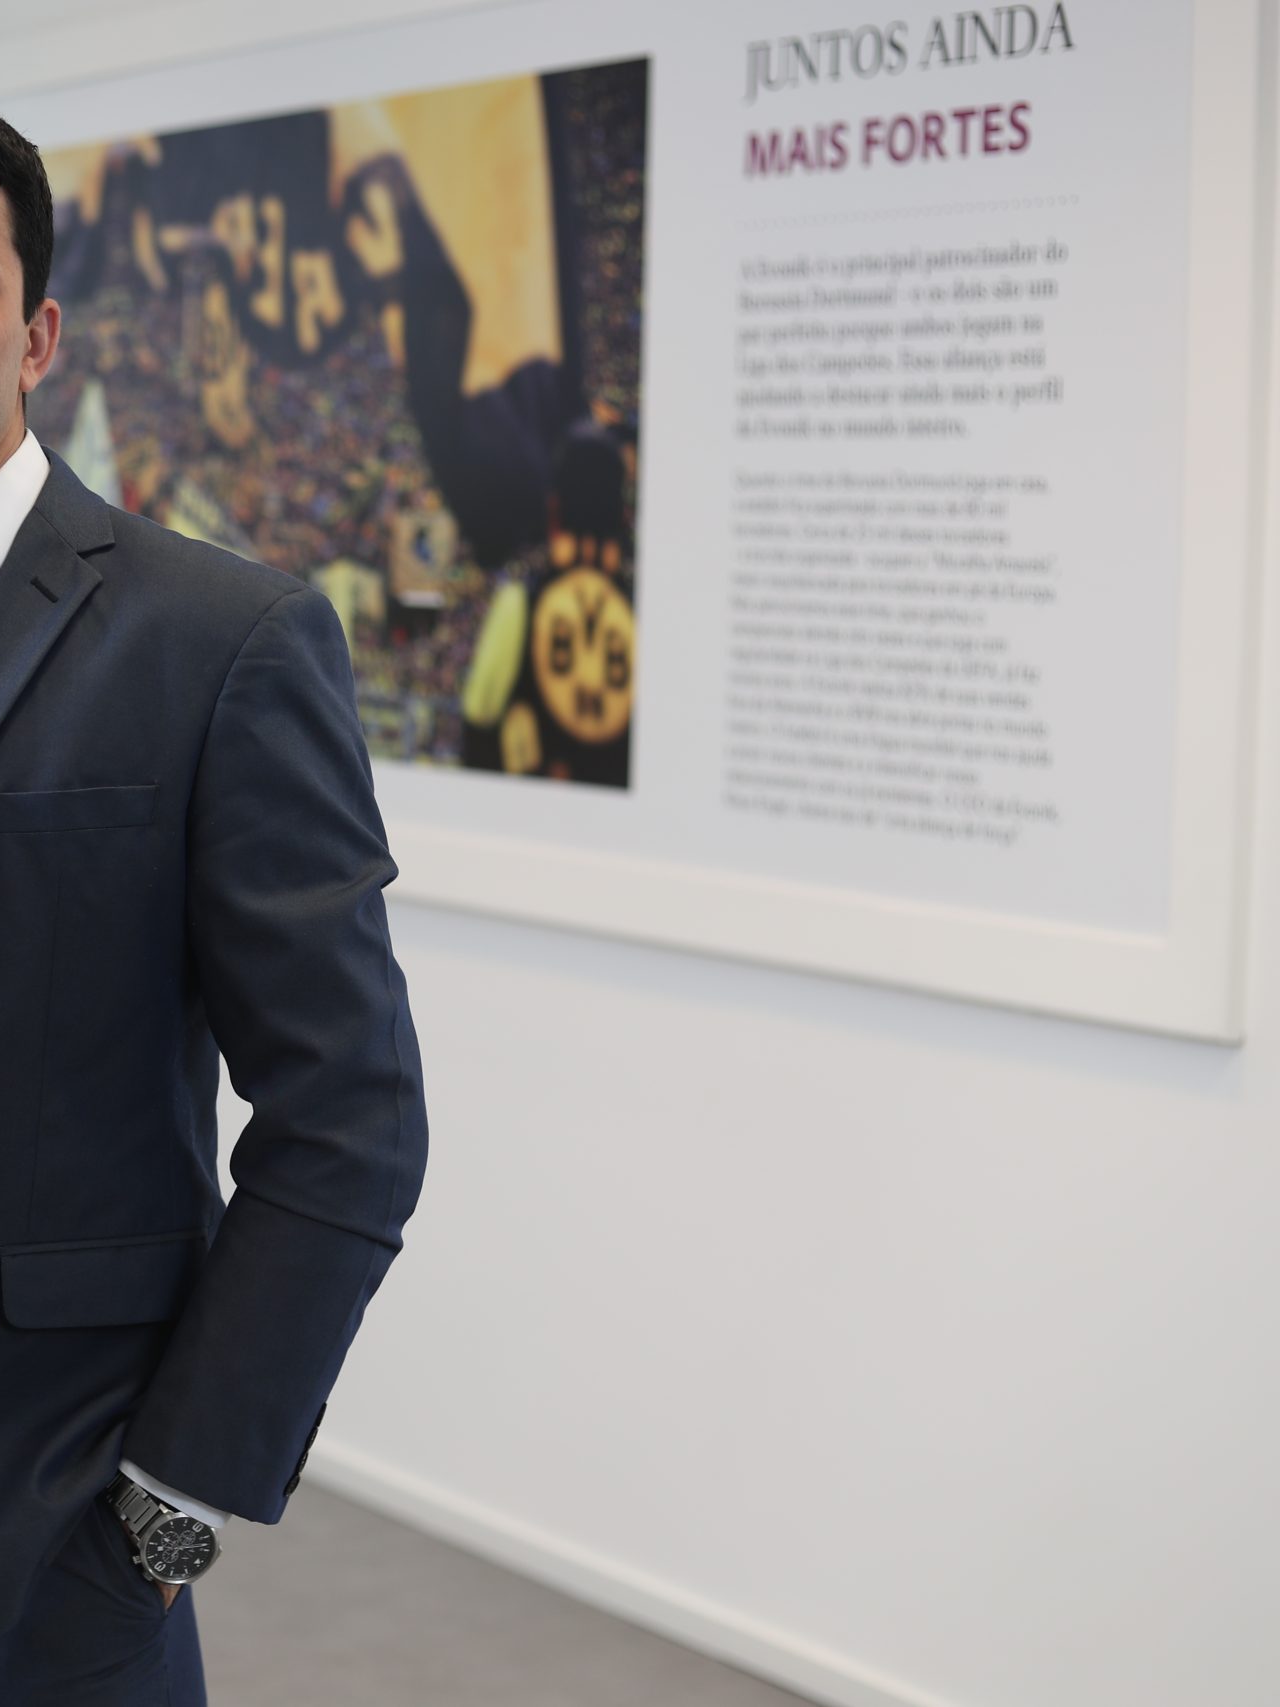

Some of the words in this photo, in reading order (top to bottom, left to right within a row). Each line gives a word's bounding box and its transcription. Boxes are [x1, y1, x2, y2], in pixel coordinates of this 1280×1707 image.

[743, 20, 909, 104] JUNTOS
[920, 1, 1076, 68] AINDA
[745, 122, 849, 178] MAIS
[862, 101, 1031, 166] FORTES
[549, 583, 631, 690] BVB
